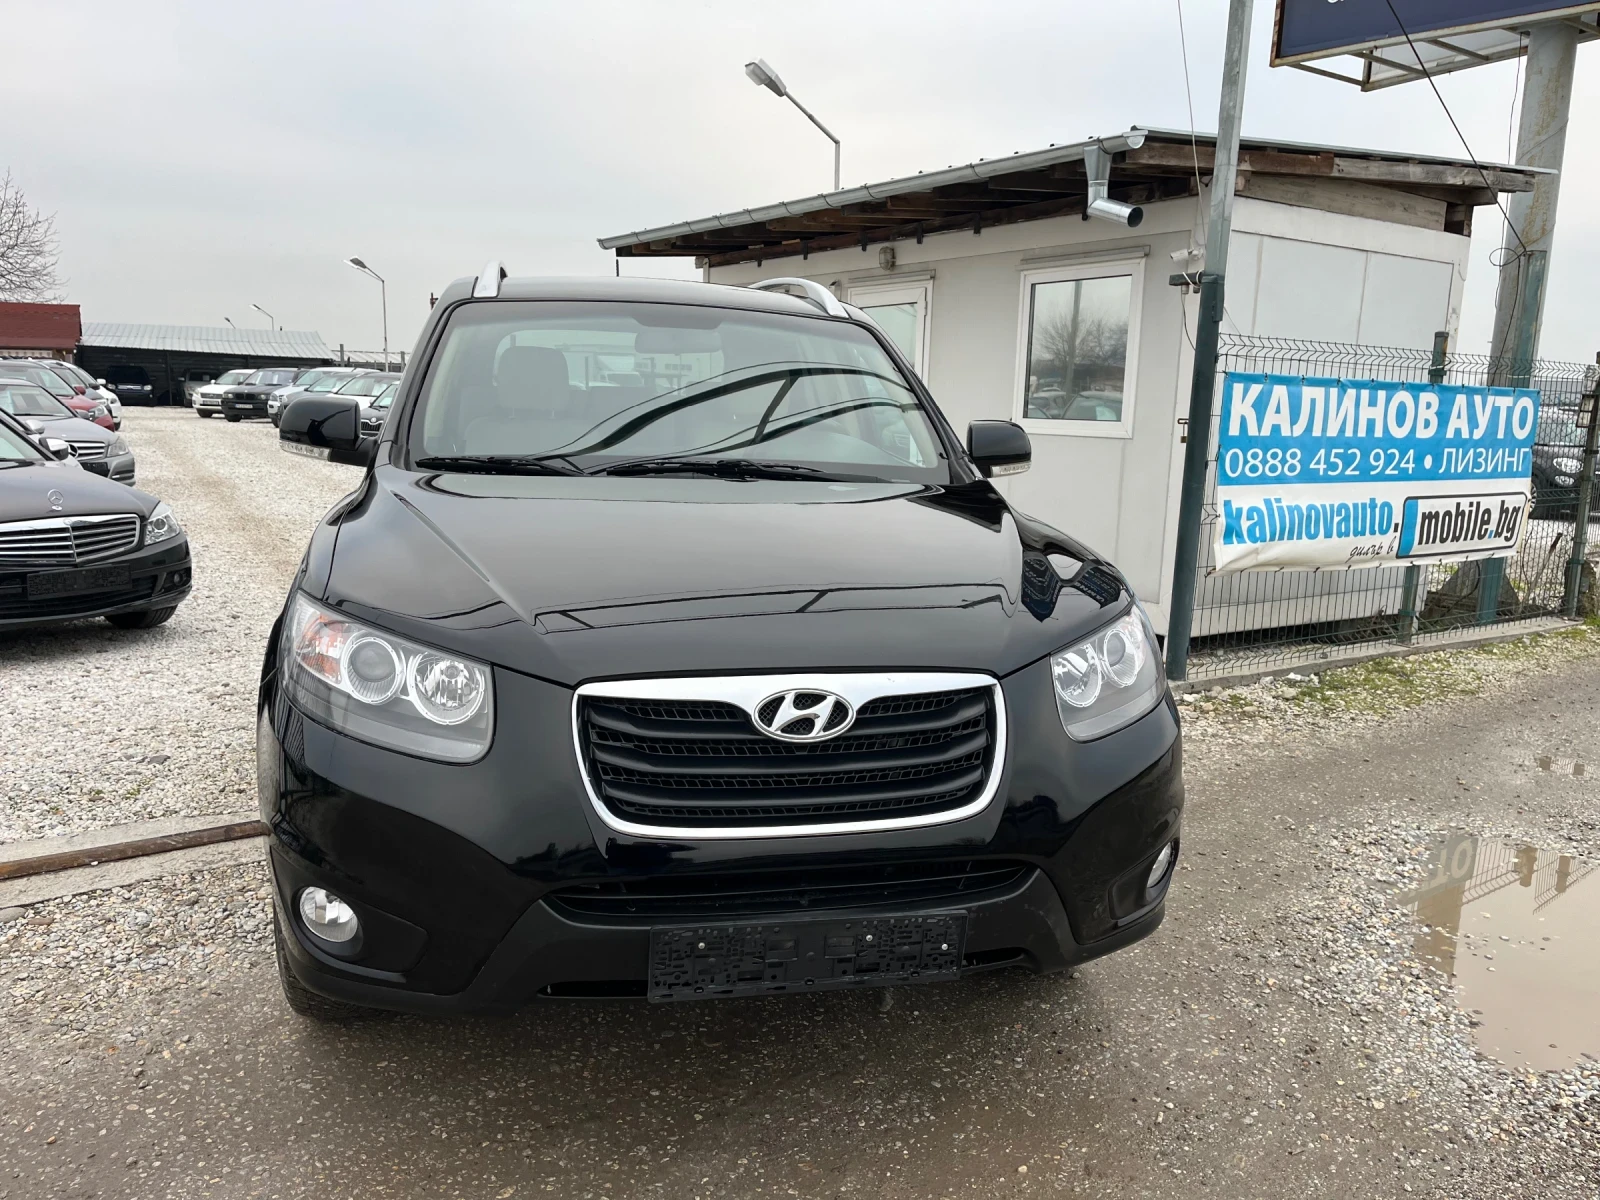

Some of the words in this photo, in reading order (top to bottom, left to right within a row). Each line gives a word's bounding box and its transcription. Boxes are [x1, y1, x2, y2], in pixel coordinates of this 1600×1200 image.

[1229, 383, 1439, 438] КАЛИНОВ
[1446, 394, 1534, 439] АУТО
[1225, 448, 1301, 477] 0888
[1310, 449, 1361, 476] 452
[1370, 449, 1415, 475] 924
[1439, 448, 1530, 474] ЛИЗИНГ
